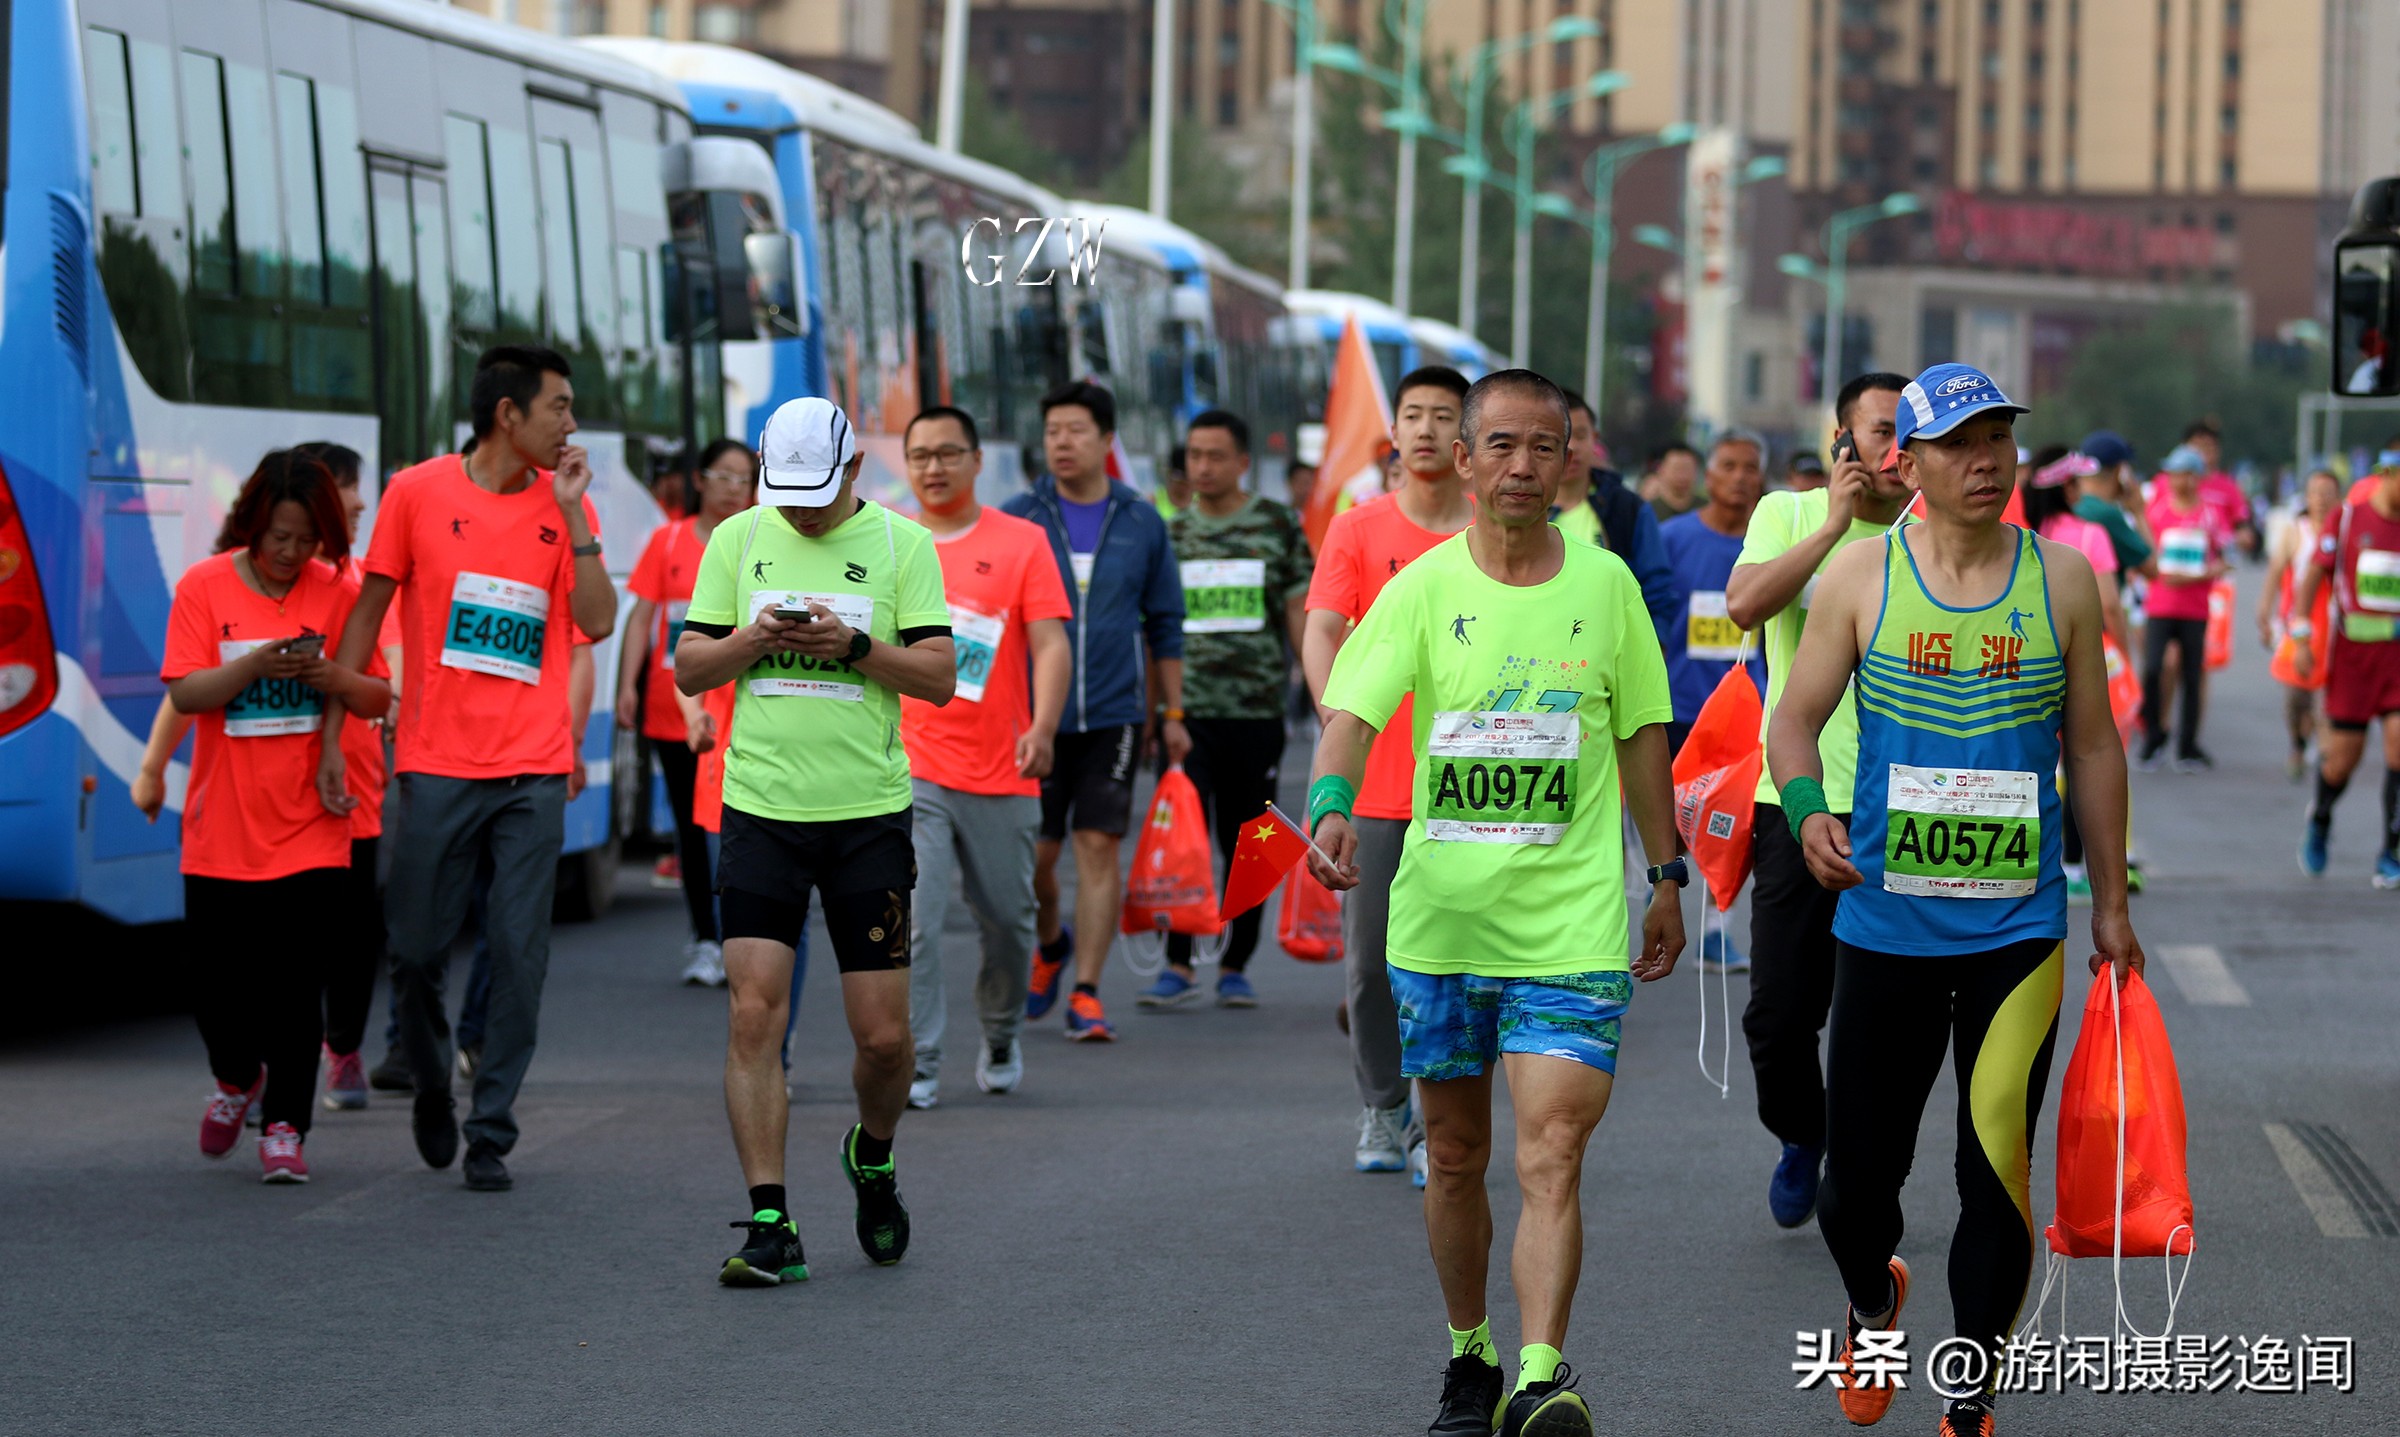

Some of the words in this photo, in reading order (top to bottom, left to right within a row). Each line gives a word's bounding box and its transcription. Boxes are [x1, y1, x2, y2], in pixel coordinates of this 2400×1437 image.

[1947, 377, 1979, 393] Ford
[453, 608, 543, 660] E4805
[1907, 632, 2023, 681] 临洮
[1434, 763, 1569, 811] A0974
[1892, 816, 2029, 868] A0574
